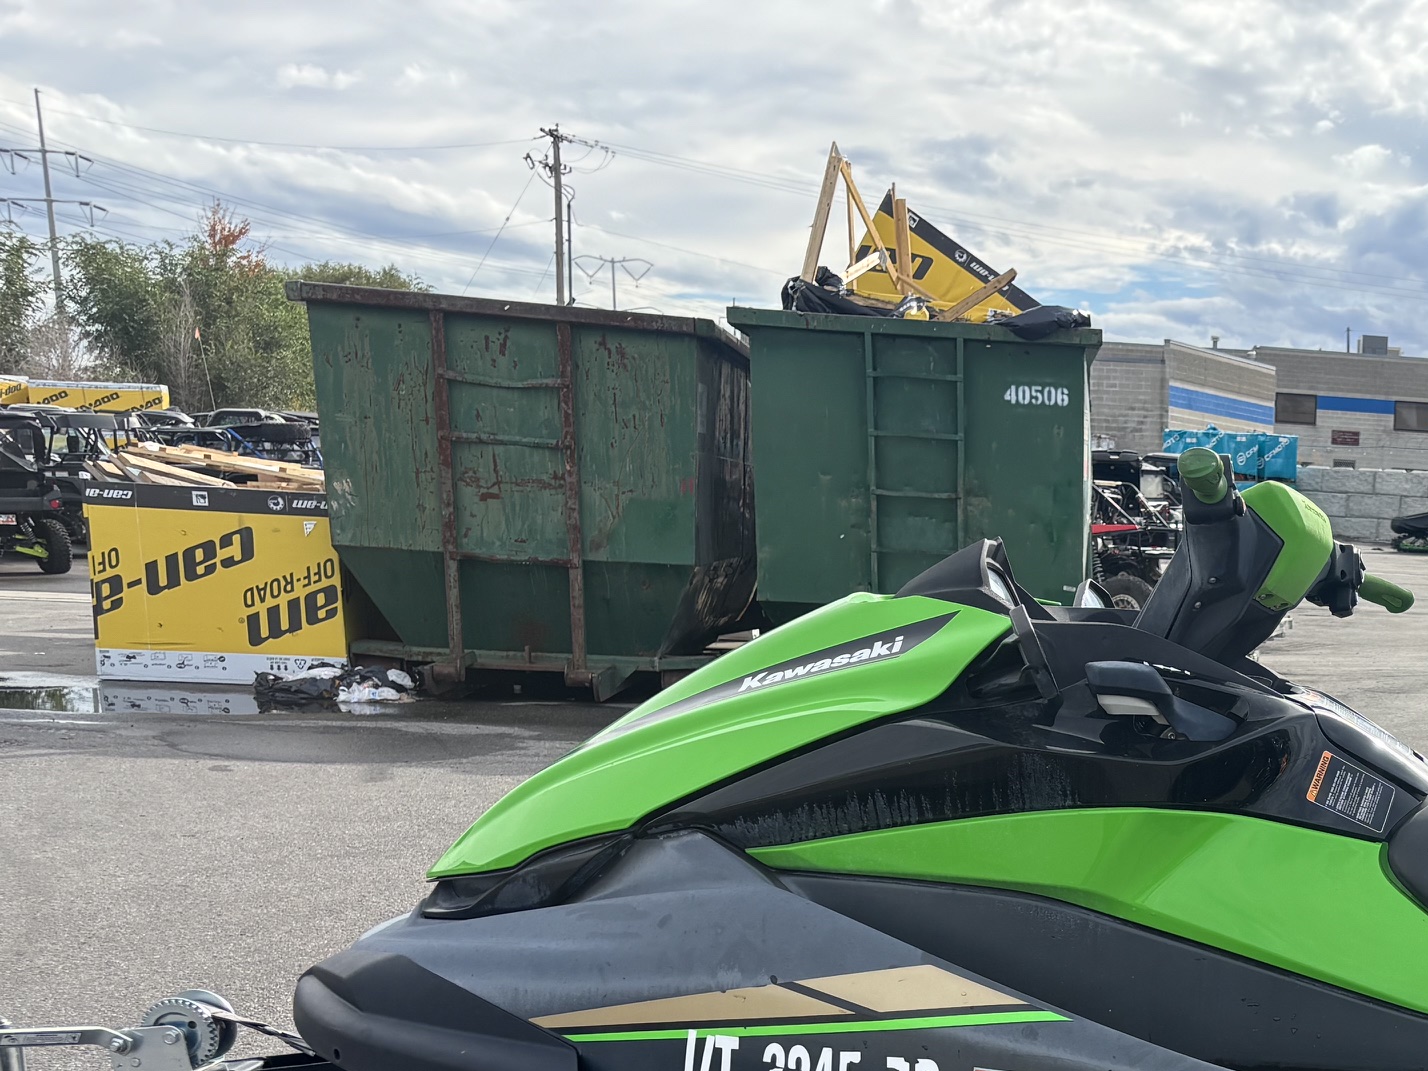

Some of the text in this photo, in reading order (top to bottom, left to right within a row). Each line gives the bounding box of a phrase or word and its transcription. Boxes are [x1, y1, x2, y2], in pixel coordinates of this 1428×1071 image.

[1004, 385, 1069, 406] 40506
[92, 526, 255, 618] can-a
[243, 558, 336, 609] OFF-ROAD
[246, 584, 339, 647] am
[738, 635, 904, 692] Kawasaki
[1312, 756, 1330, 789] WARNING
